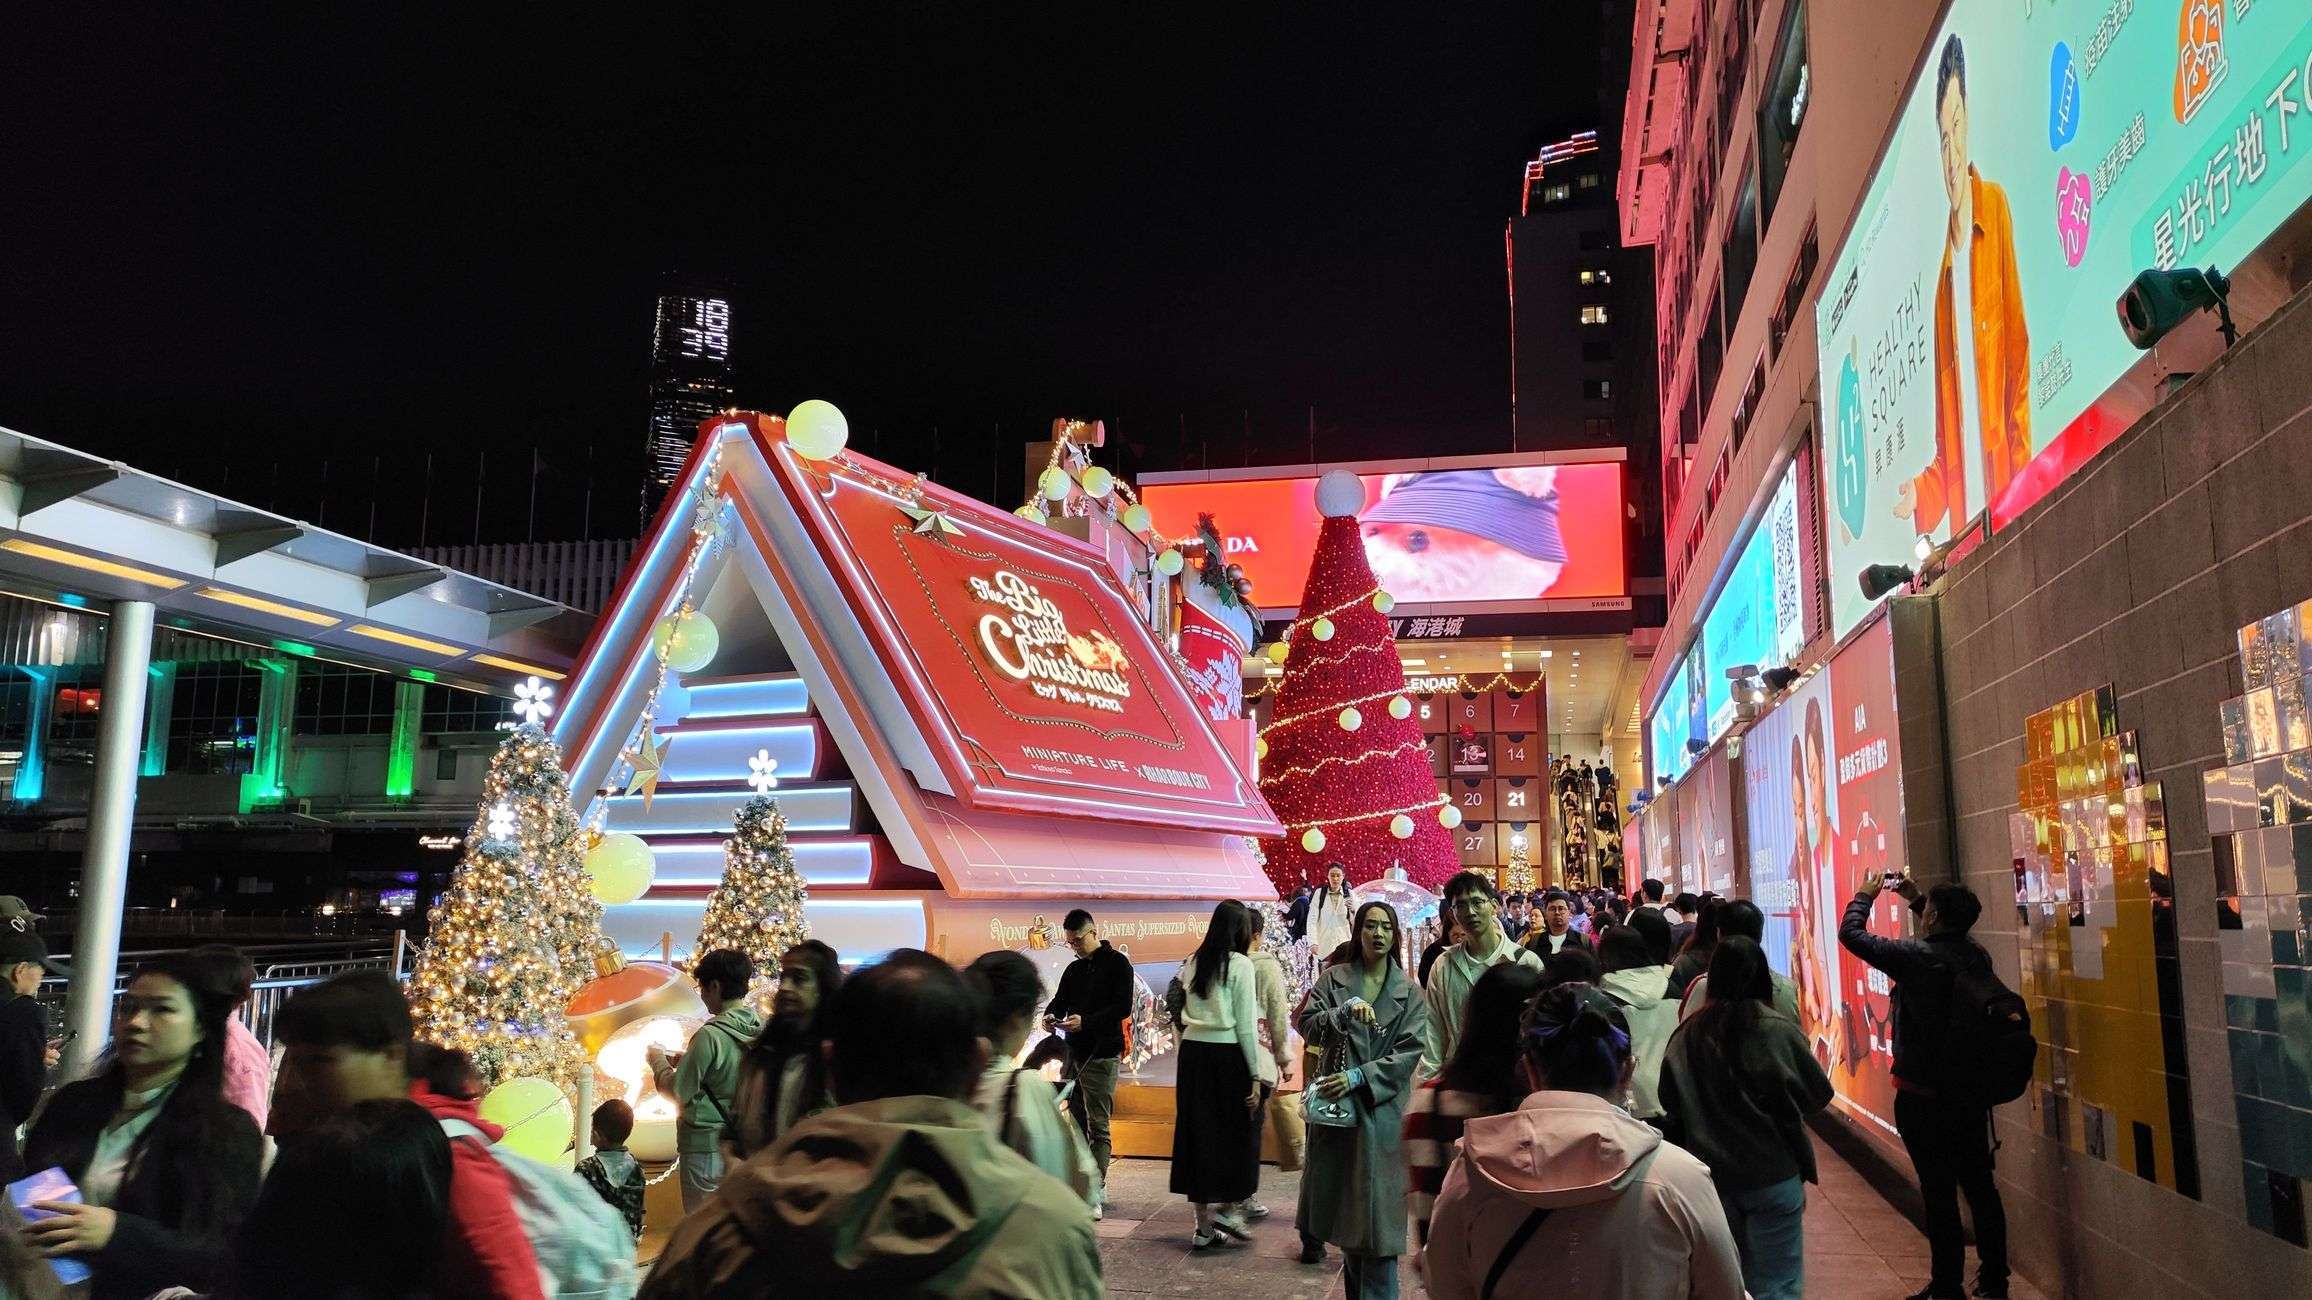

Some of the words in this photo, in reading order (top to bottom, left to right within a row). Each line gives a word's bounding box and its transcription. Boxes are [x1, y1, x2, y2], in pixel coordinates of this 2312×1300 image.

[2095, 112, 2146, 203] 護牙美齒
[2153, 50, 2312, 272] 星光行地下
[1868, 271, 1922, 389] HEALTHY
[1871, 324, 1926, 432] SQUARE
[995, 570, 1064, 624] Big
[1591, 600, 1625, 608] SAMSUNG
[1011, 613, 1068, 648] Little
[1407, 616, 1464, 638] 海港城
[979, 614, 1131, 698] Christmas
[1420, 705, 1431, 719] 5
[1466, 705, 1475, 718] 6
[1510, 704, 1519, 718] 7
[1854, 703, 1867, 734] AIA
[1020, 744, 1099, 769] MINIATURE
[1098, 757, 1130, 773] LIFE
[1507, 748, 1524, 762] 14
[1463, 793, 1482, 806] 20
[1507, 792, 1525, 807] 21
[1464, 836, 1483, 850] 27
